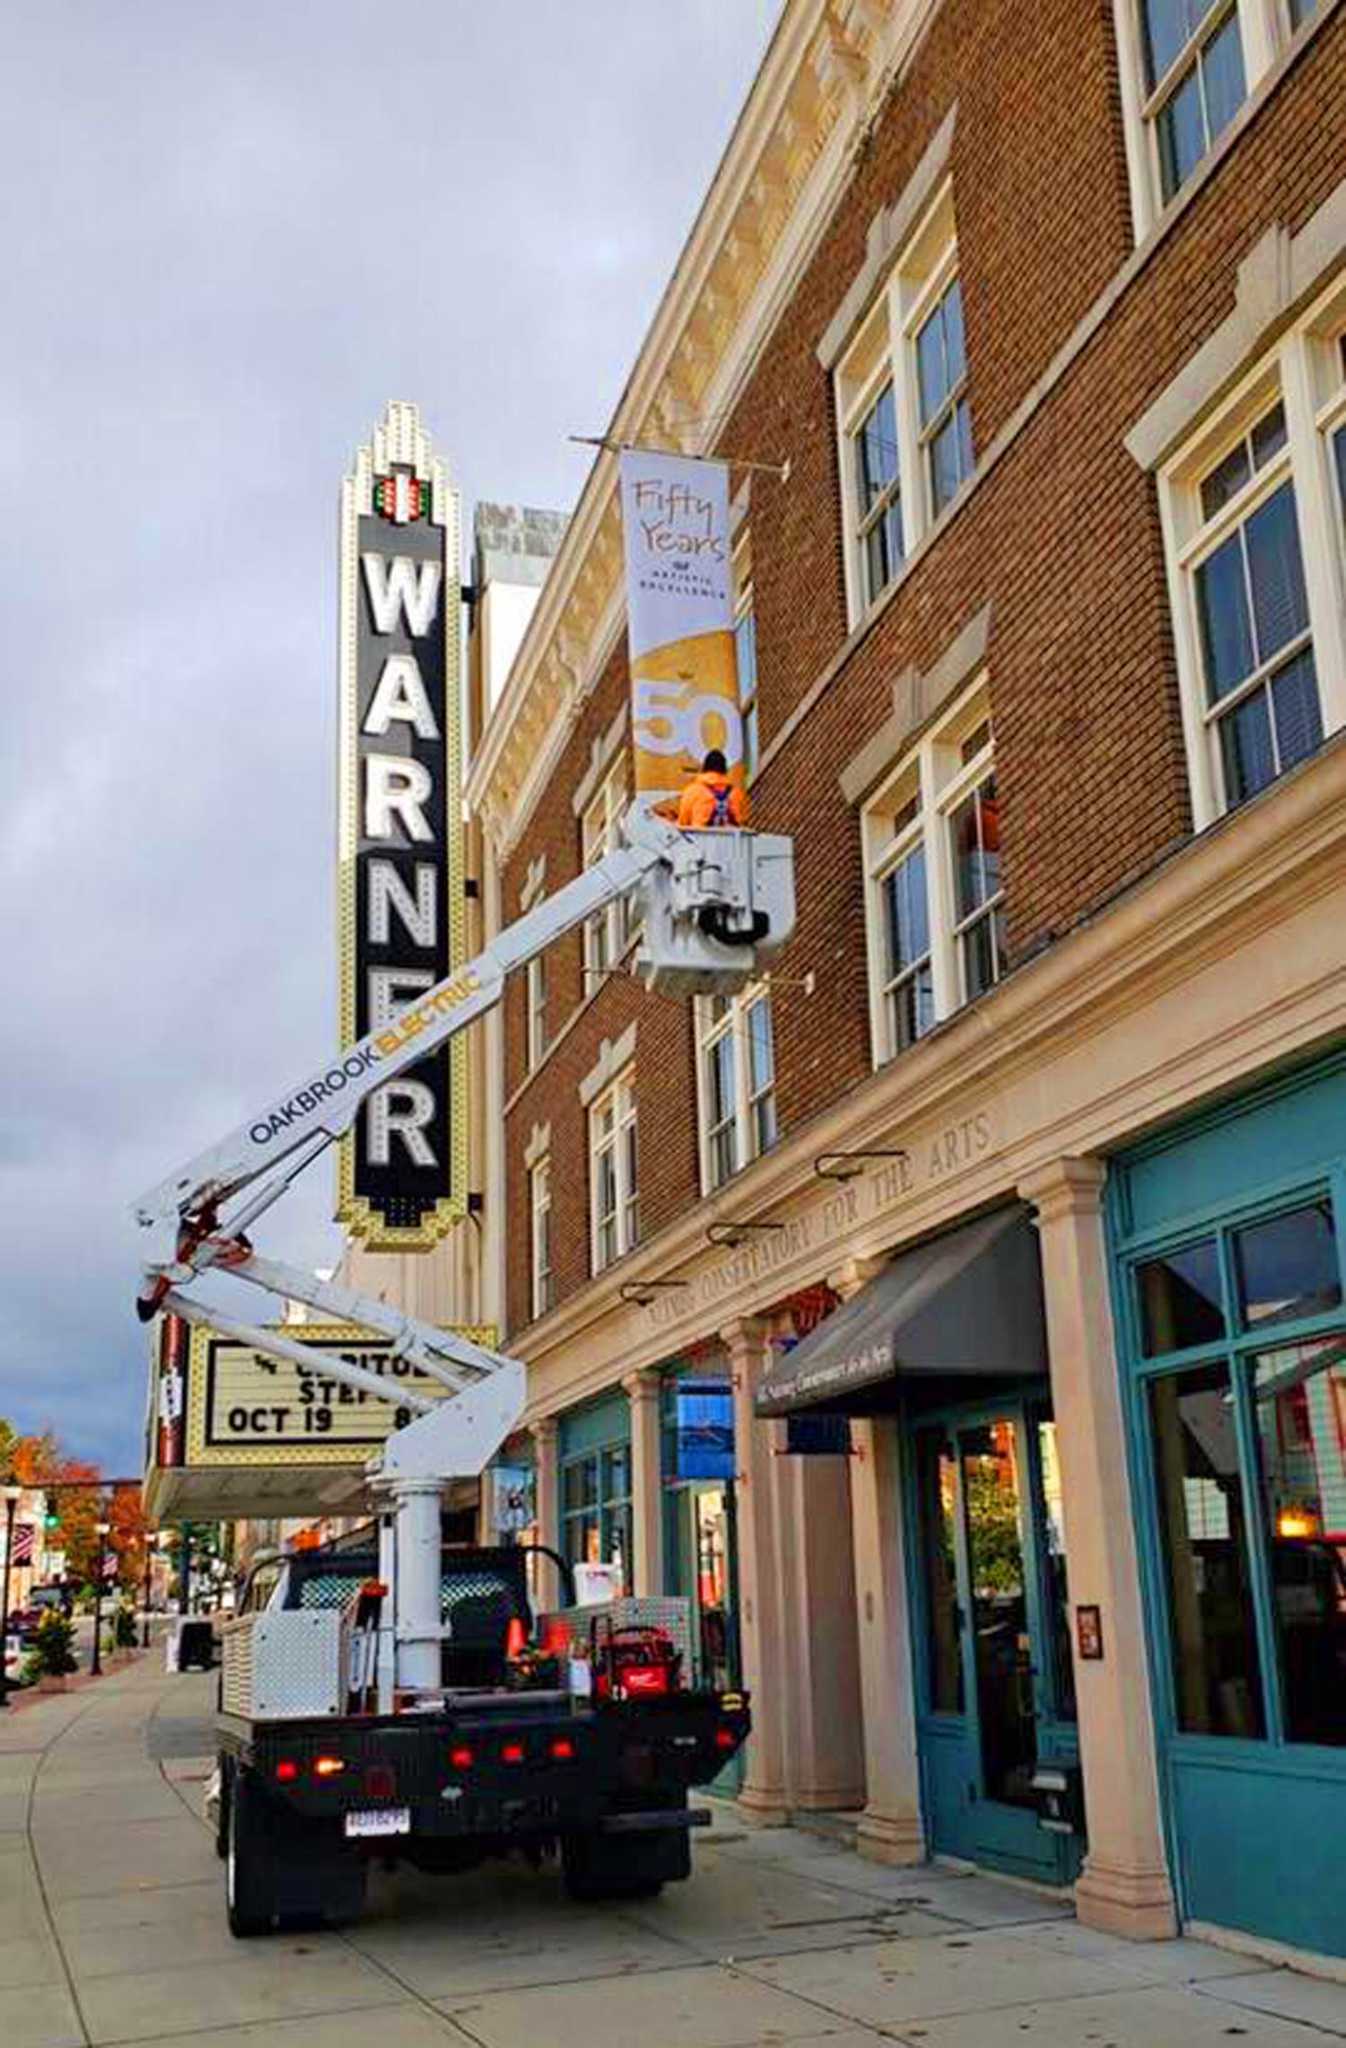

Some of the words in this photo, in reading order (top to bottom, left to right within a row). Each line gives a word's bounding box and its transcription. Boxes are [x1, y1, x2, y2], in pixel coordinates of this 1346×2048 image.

[632, 478, 712, 537] Fifty
[640, 520, 725, 562] Years
[631, 679, 744, 772] 50
[361, 551, 443, 1166] WARNER
[249, 1046, 381, 1145] OAKBROOK
[374, 976, 480, 1054] ELECTRIC
[868, 1155, 914, 1206] THE
[928, 1111, 992, 1179] ARTS
[229, 1407, 290, 1432] OCT
[304, 1407, 332, 1432] 19
